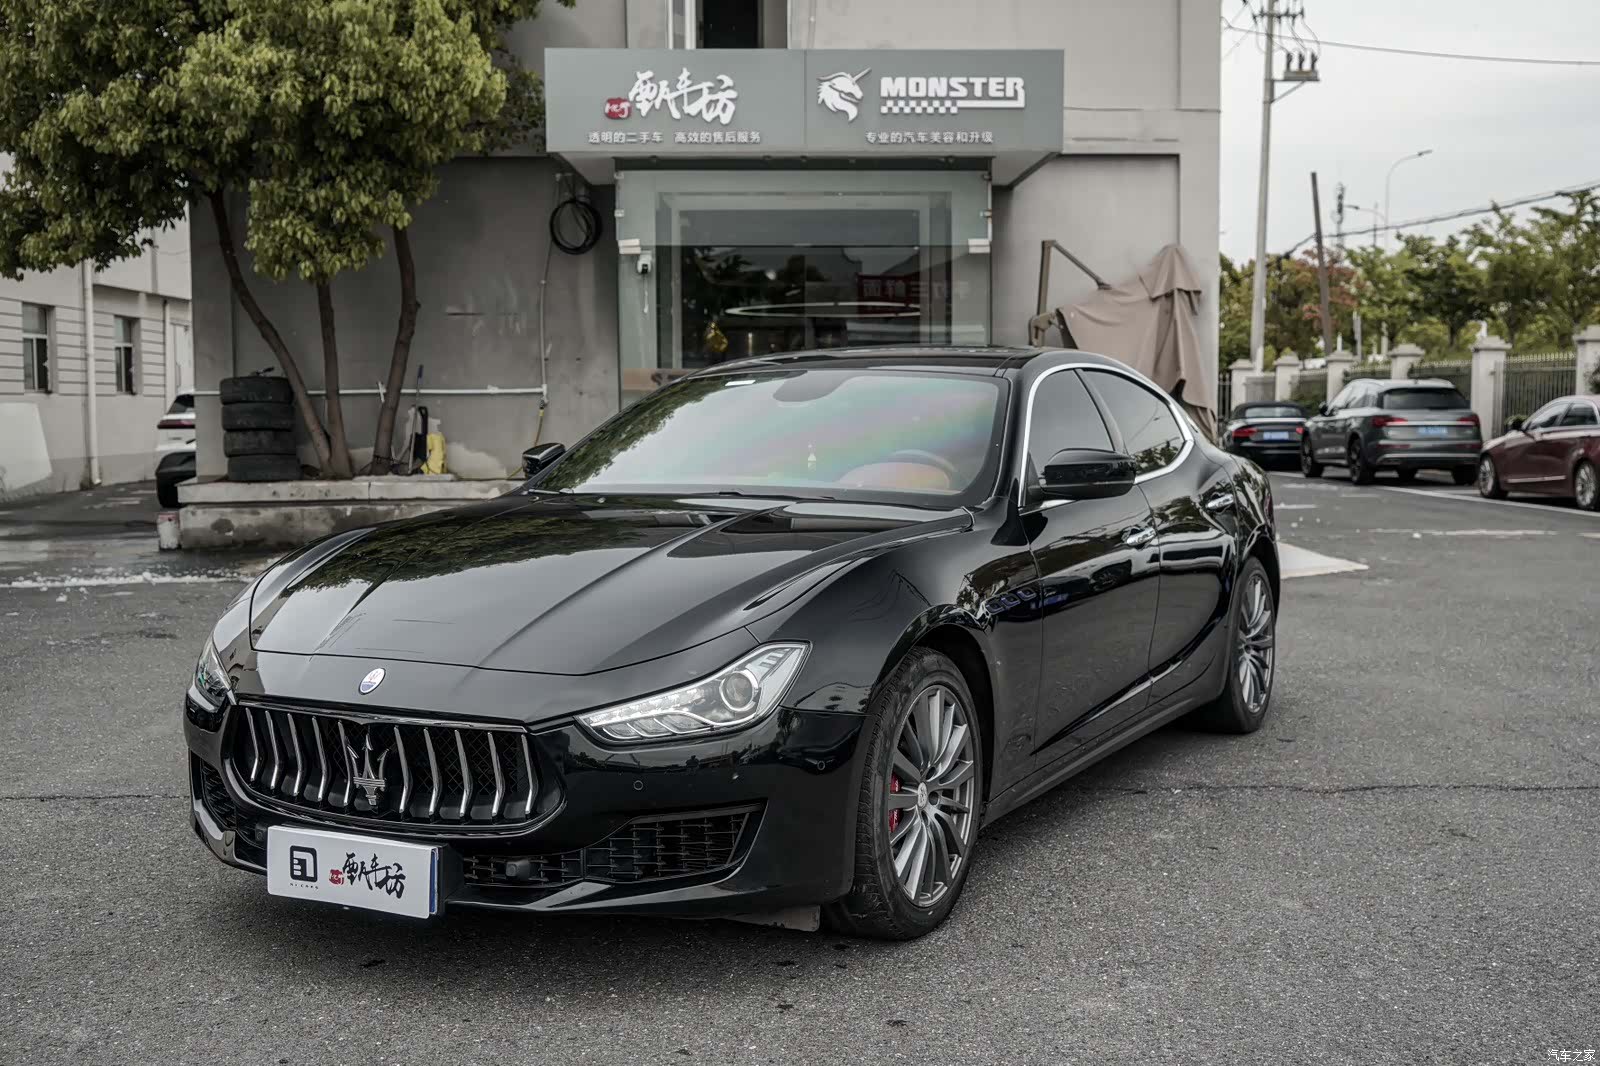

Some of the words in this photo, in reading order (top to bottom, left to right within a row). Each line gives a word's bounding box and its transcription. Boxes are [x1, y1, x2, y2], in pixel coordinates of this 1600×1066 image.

[880, 76, 1025, 100] MONSTER
[588, 131, 663, 144] 透明的二手车
[674, 131, 761, 144] 高效的售后服务
[865, 131, 994, 144] 专业的汽车美容和升级
